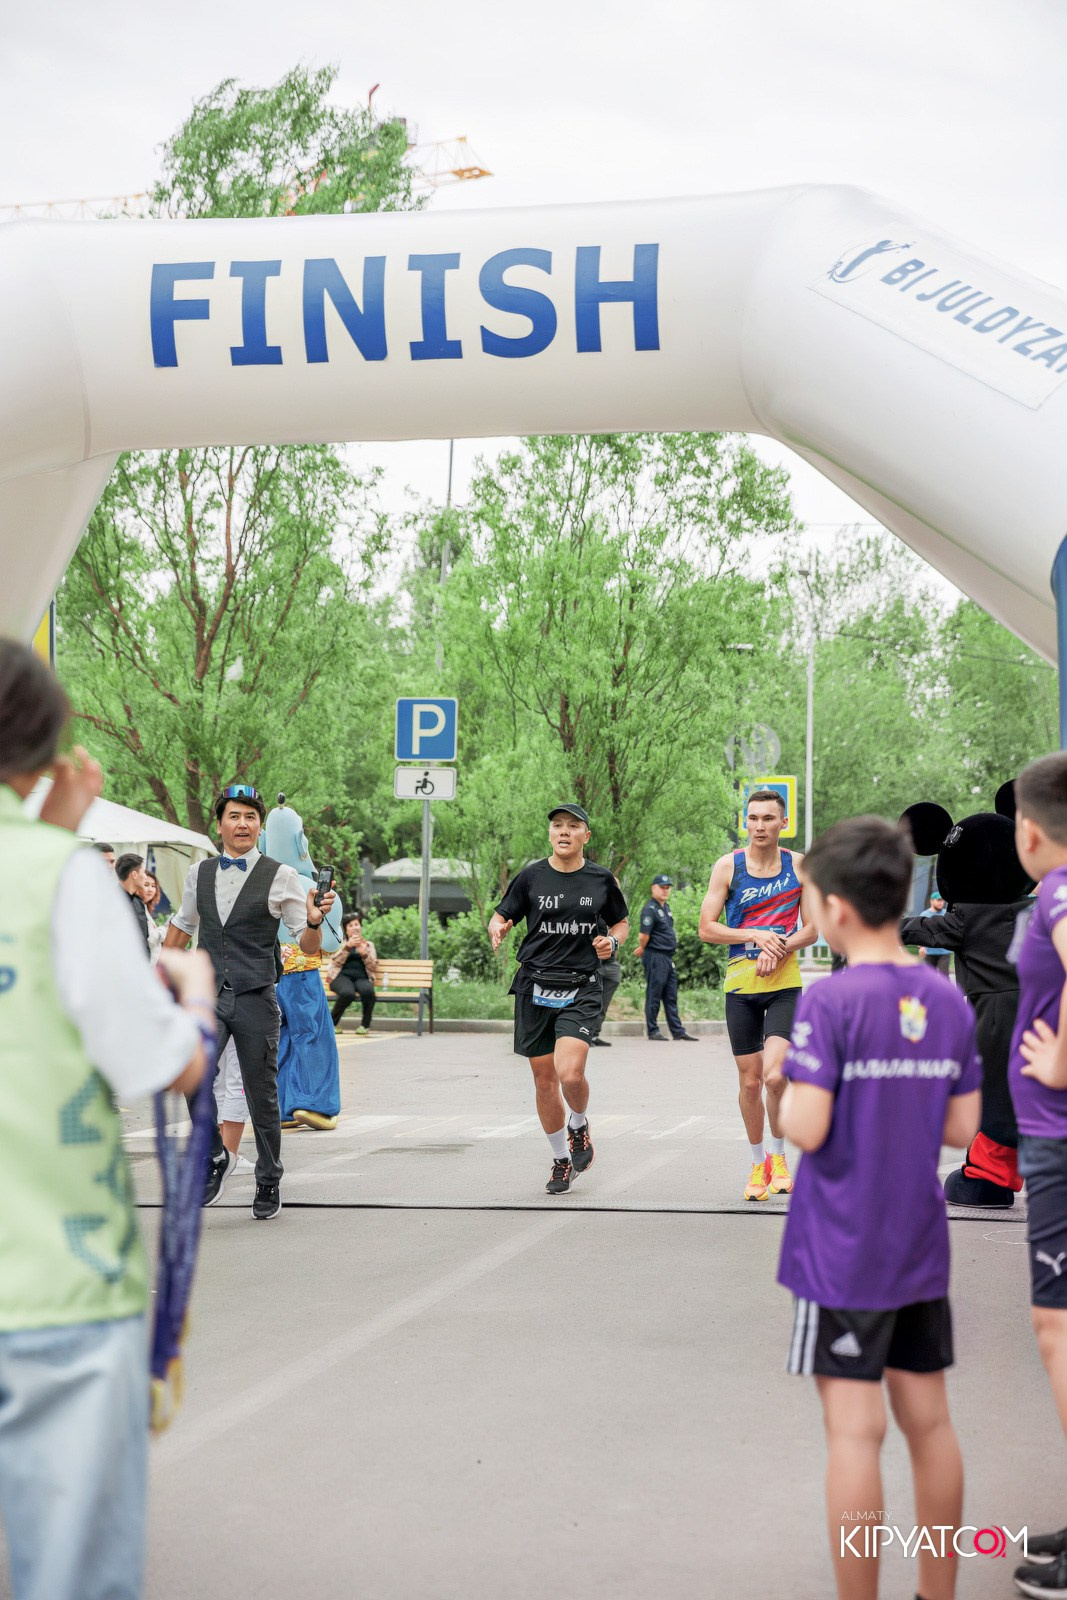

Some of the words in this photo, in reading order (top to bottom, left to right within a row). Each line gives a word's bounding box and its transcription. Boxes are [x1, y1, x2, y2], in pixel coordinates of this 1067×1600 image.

[150, 243, 661, 368] FINISH
[880, 258, 939, 292] BI
[916, 279, 1067, 374] JULDYZA
[411, 703, 446, 755] P
